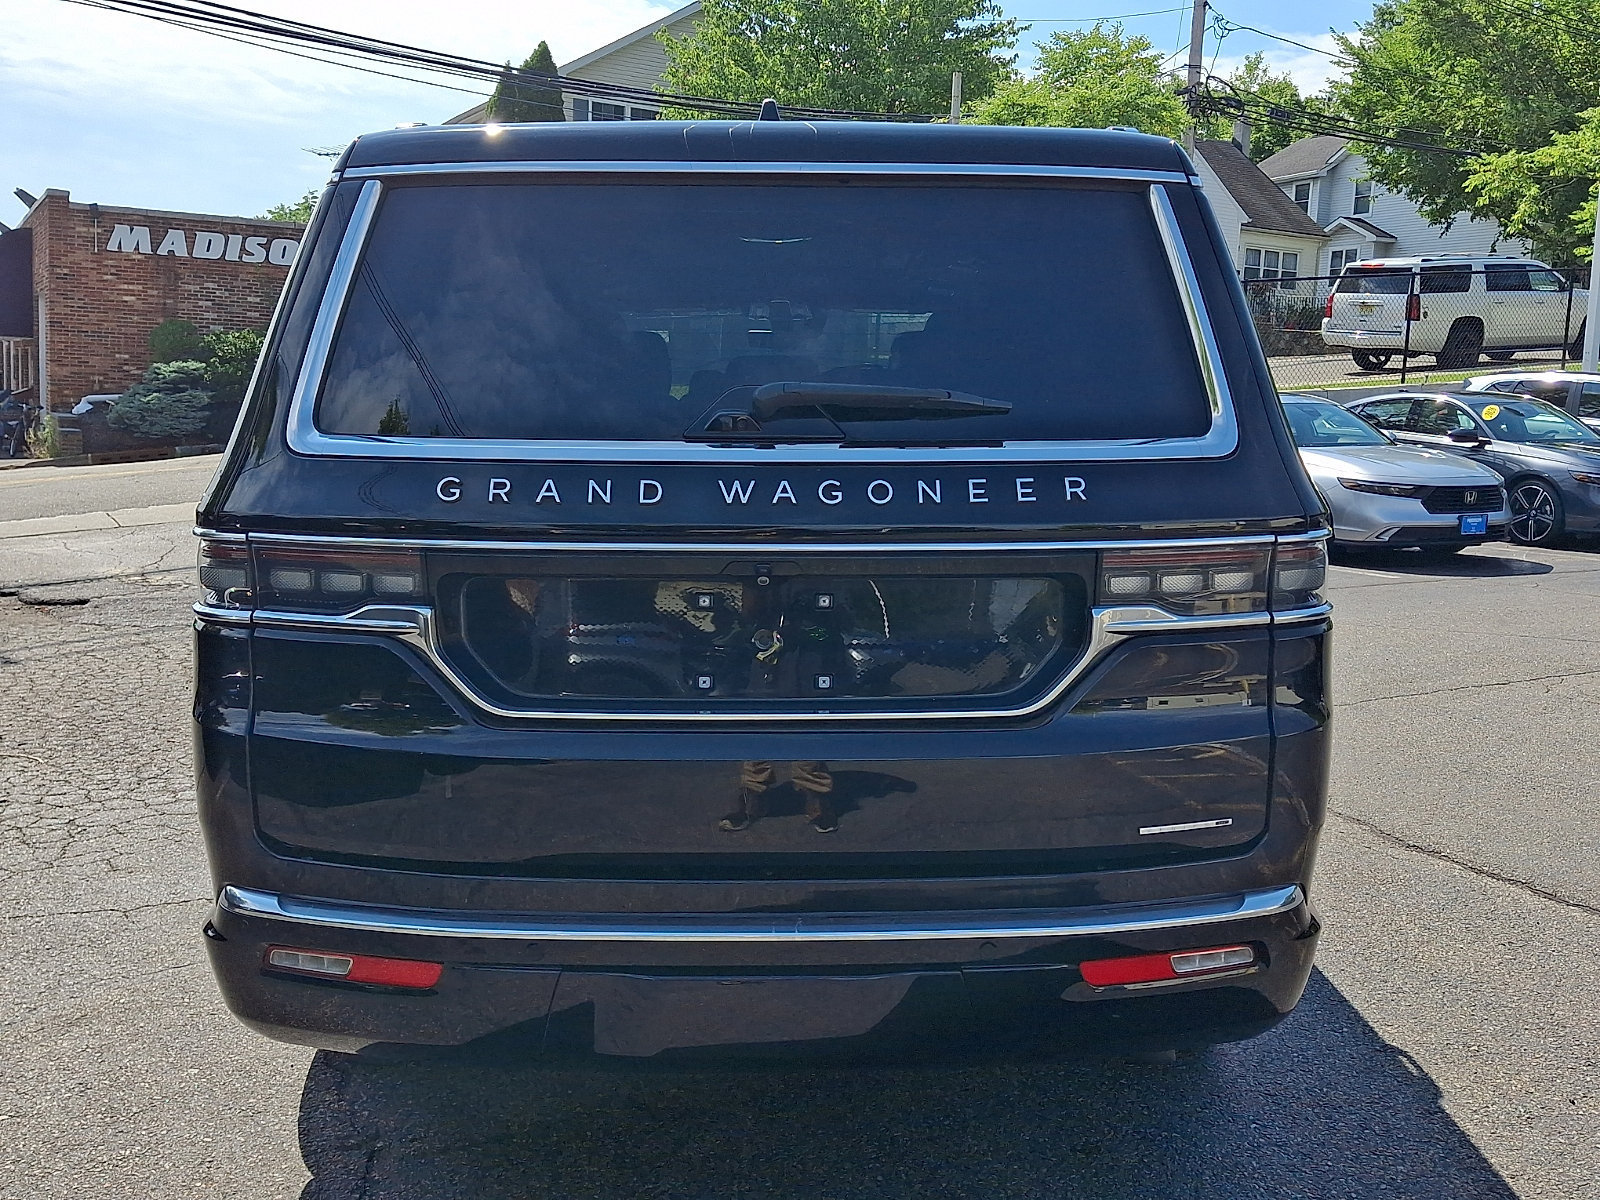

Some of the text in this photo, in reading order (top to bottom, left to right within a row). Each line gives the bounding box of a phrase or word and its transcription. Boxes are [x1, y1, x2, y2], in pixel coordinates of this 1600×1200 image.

[106, 224, 299, 265] MADISO
[436, 476, 1088, 504] GRAND WAGONEER
